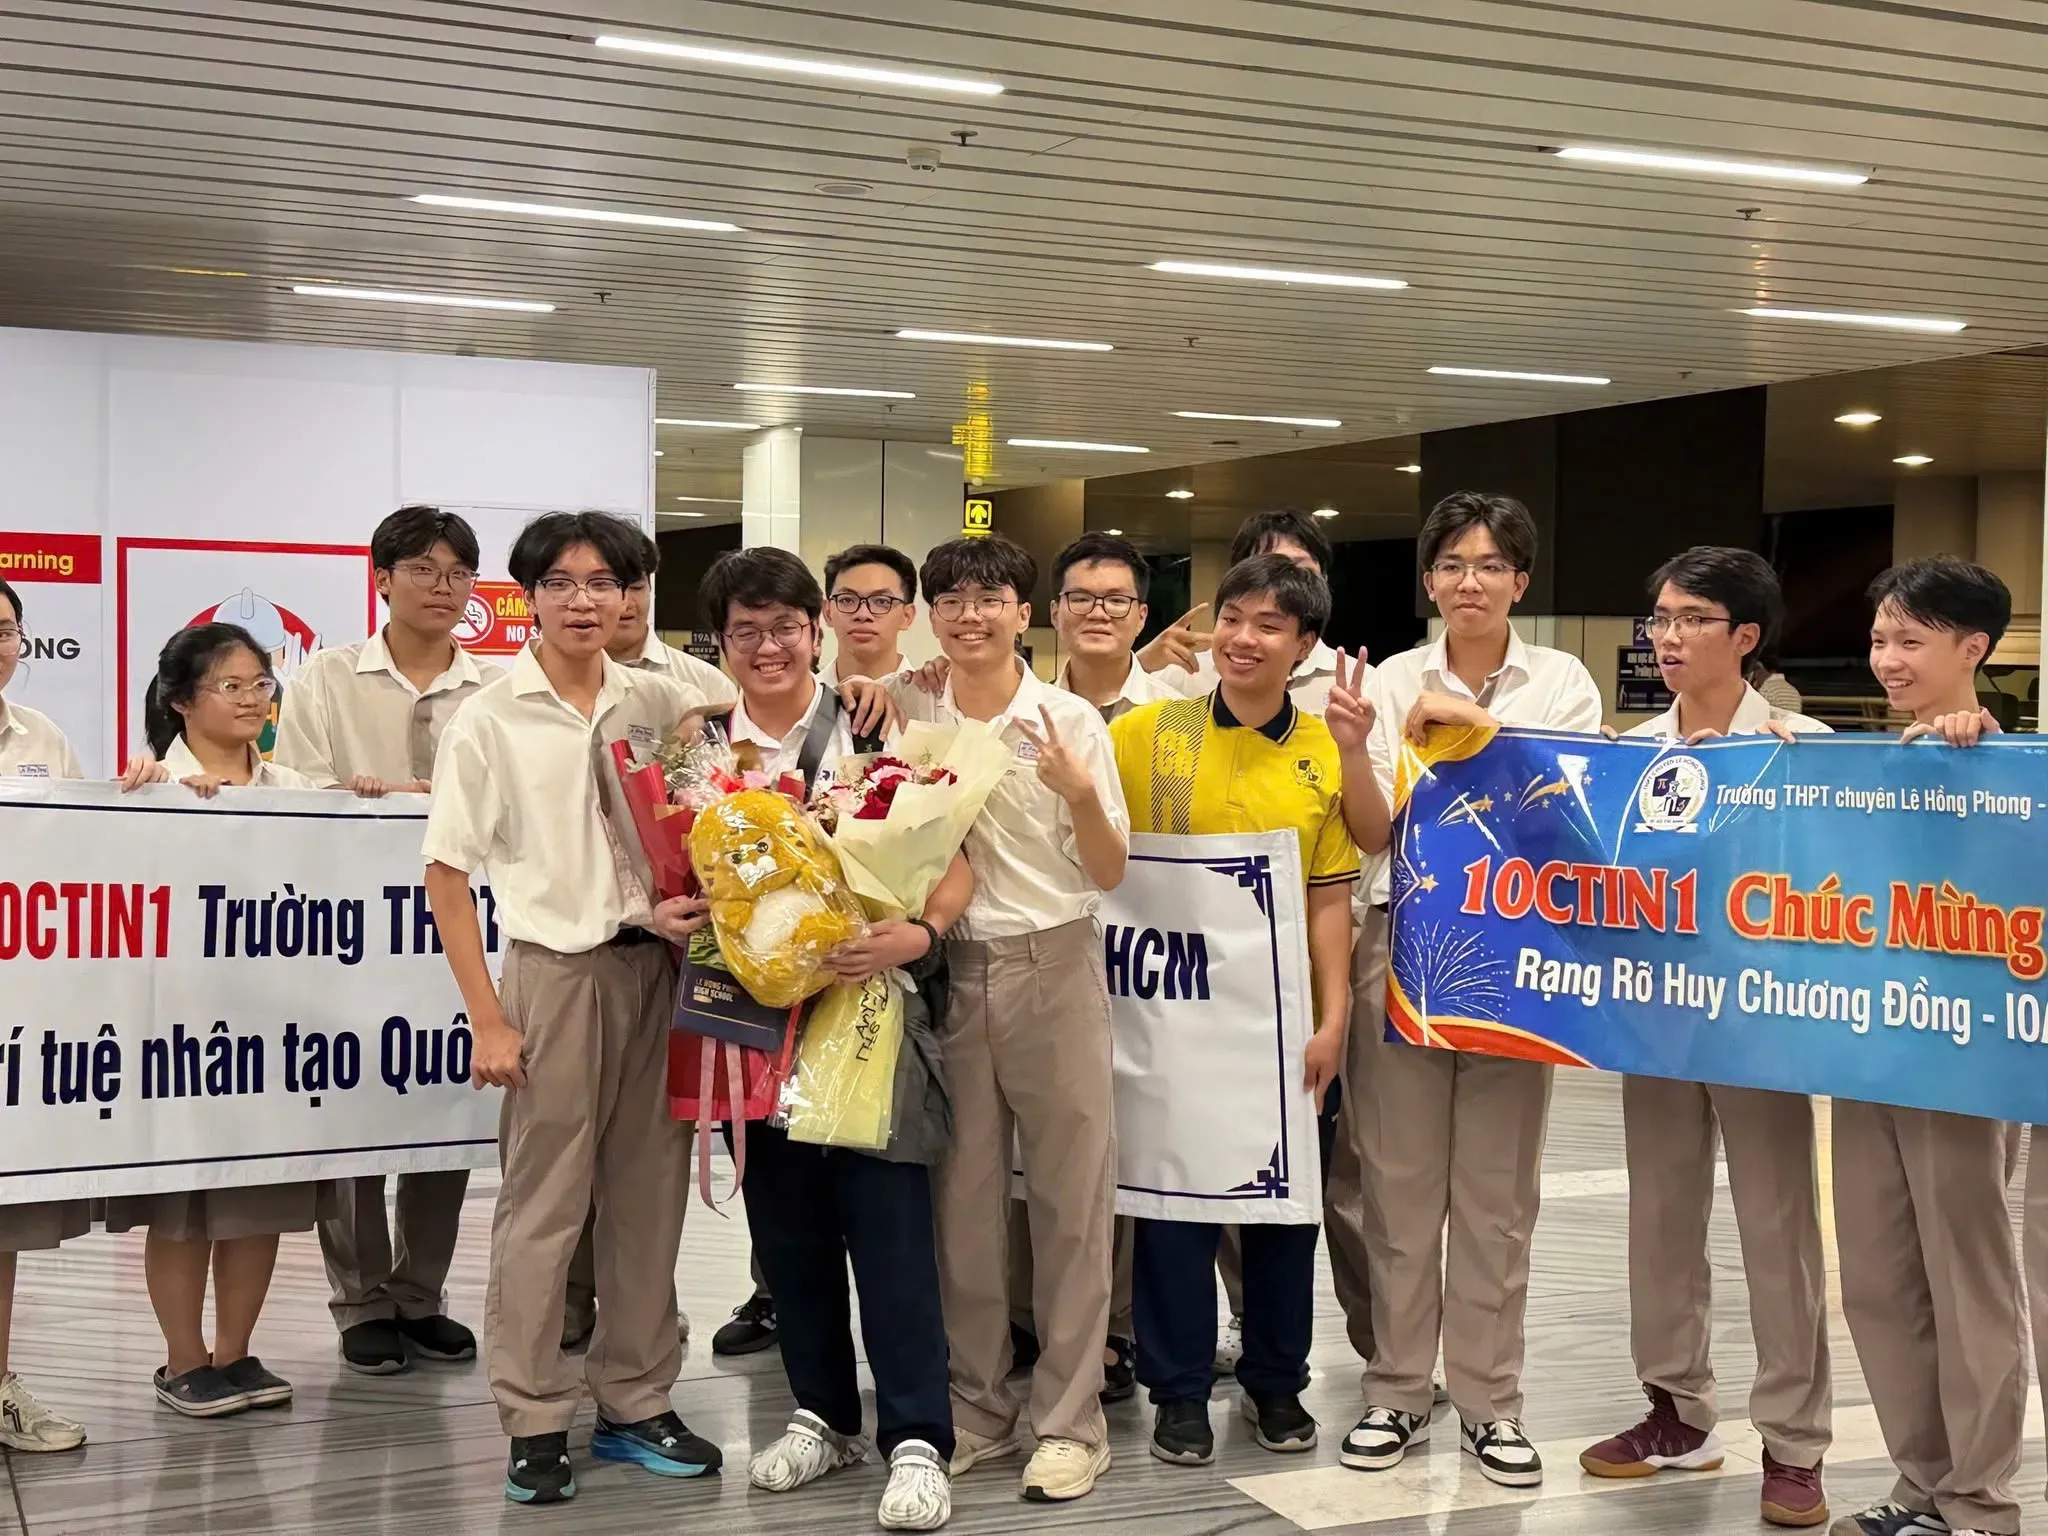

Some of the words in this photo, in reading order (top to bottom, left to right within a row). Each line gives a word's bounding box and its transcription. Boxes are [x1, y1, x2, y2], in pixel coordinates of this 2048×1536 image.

[506, 625, 525, 642] NO
[1716, 783, 1777, 810] Trường
[1783, 784, 1830, 807] THPT
[1835, 786, 1896, 814] chuyên
[1901, 787, 1920, 810] Lê
[1924, 784, 1967, 818] Hồng
[1973, 790, 2031, 821] Phong
[199, 883, 364, 965] Trường
[383, 885, 498, 954] THT
[1105, 925, 1210, 1000] HCM
[1726, 871, 1877, 948] Chúc
[1885, 879, 2048, 980] Mừng
[1515, 947, 1601, 1007] Rạng
[1612, 957, 1653, 1002] Rỡ
[1663, 962, 1726, 1020] Huy
[1738, 969, 1871, 1034] Chương
[1882, 976, 1970, 1045] Đồng
[2006, 992, 2048, 1044] IO
[41, 1023, 121, 1120] tuệ
[142, 1020, 265, 1099] nhân
[283, 1022, 360, 1108] tạo
